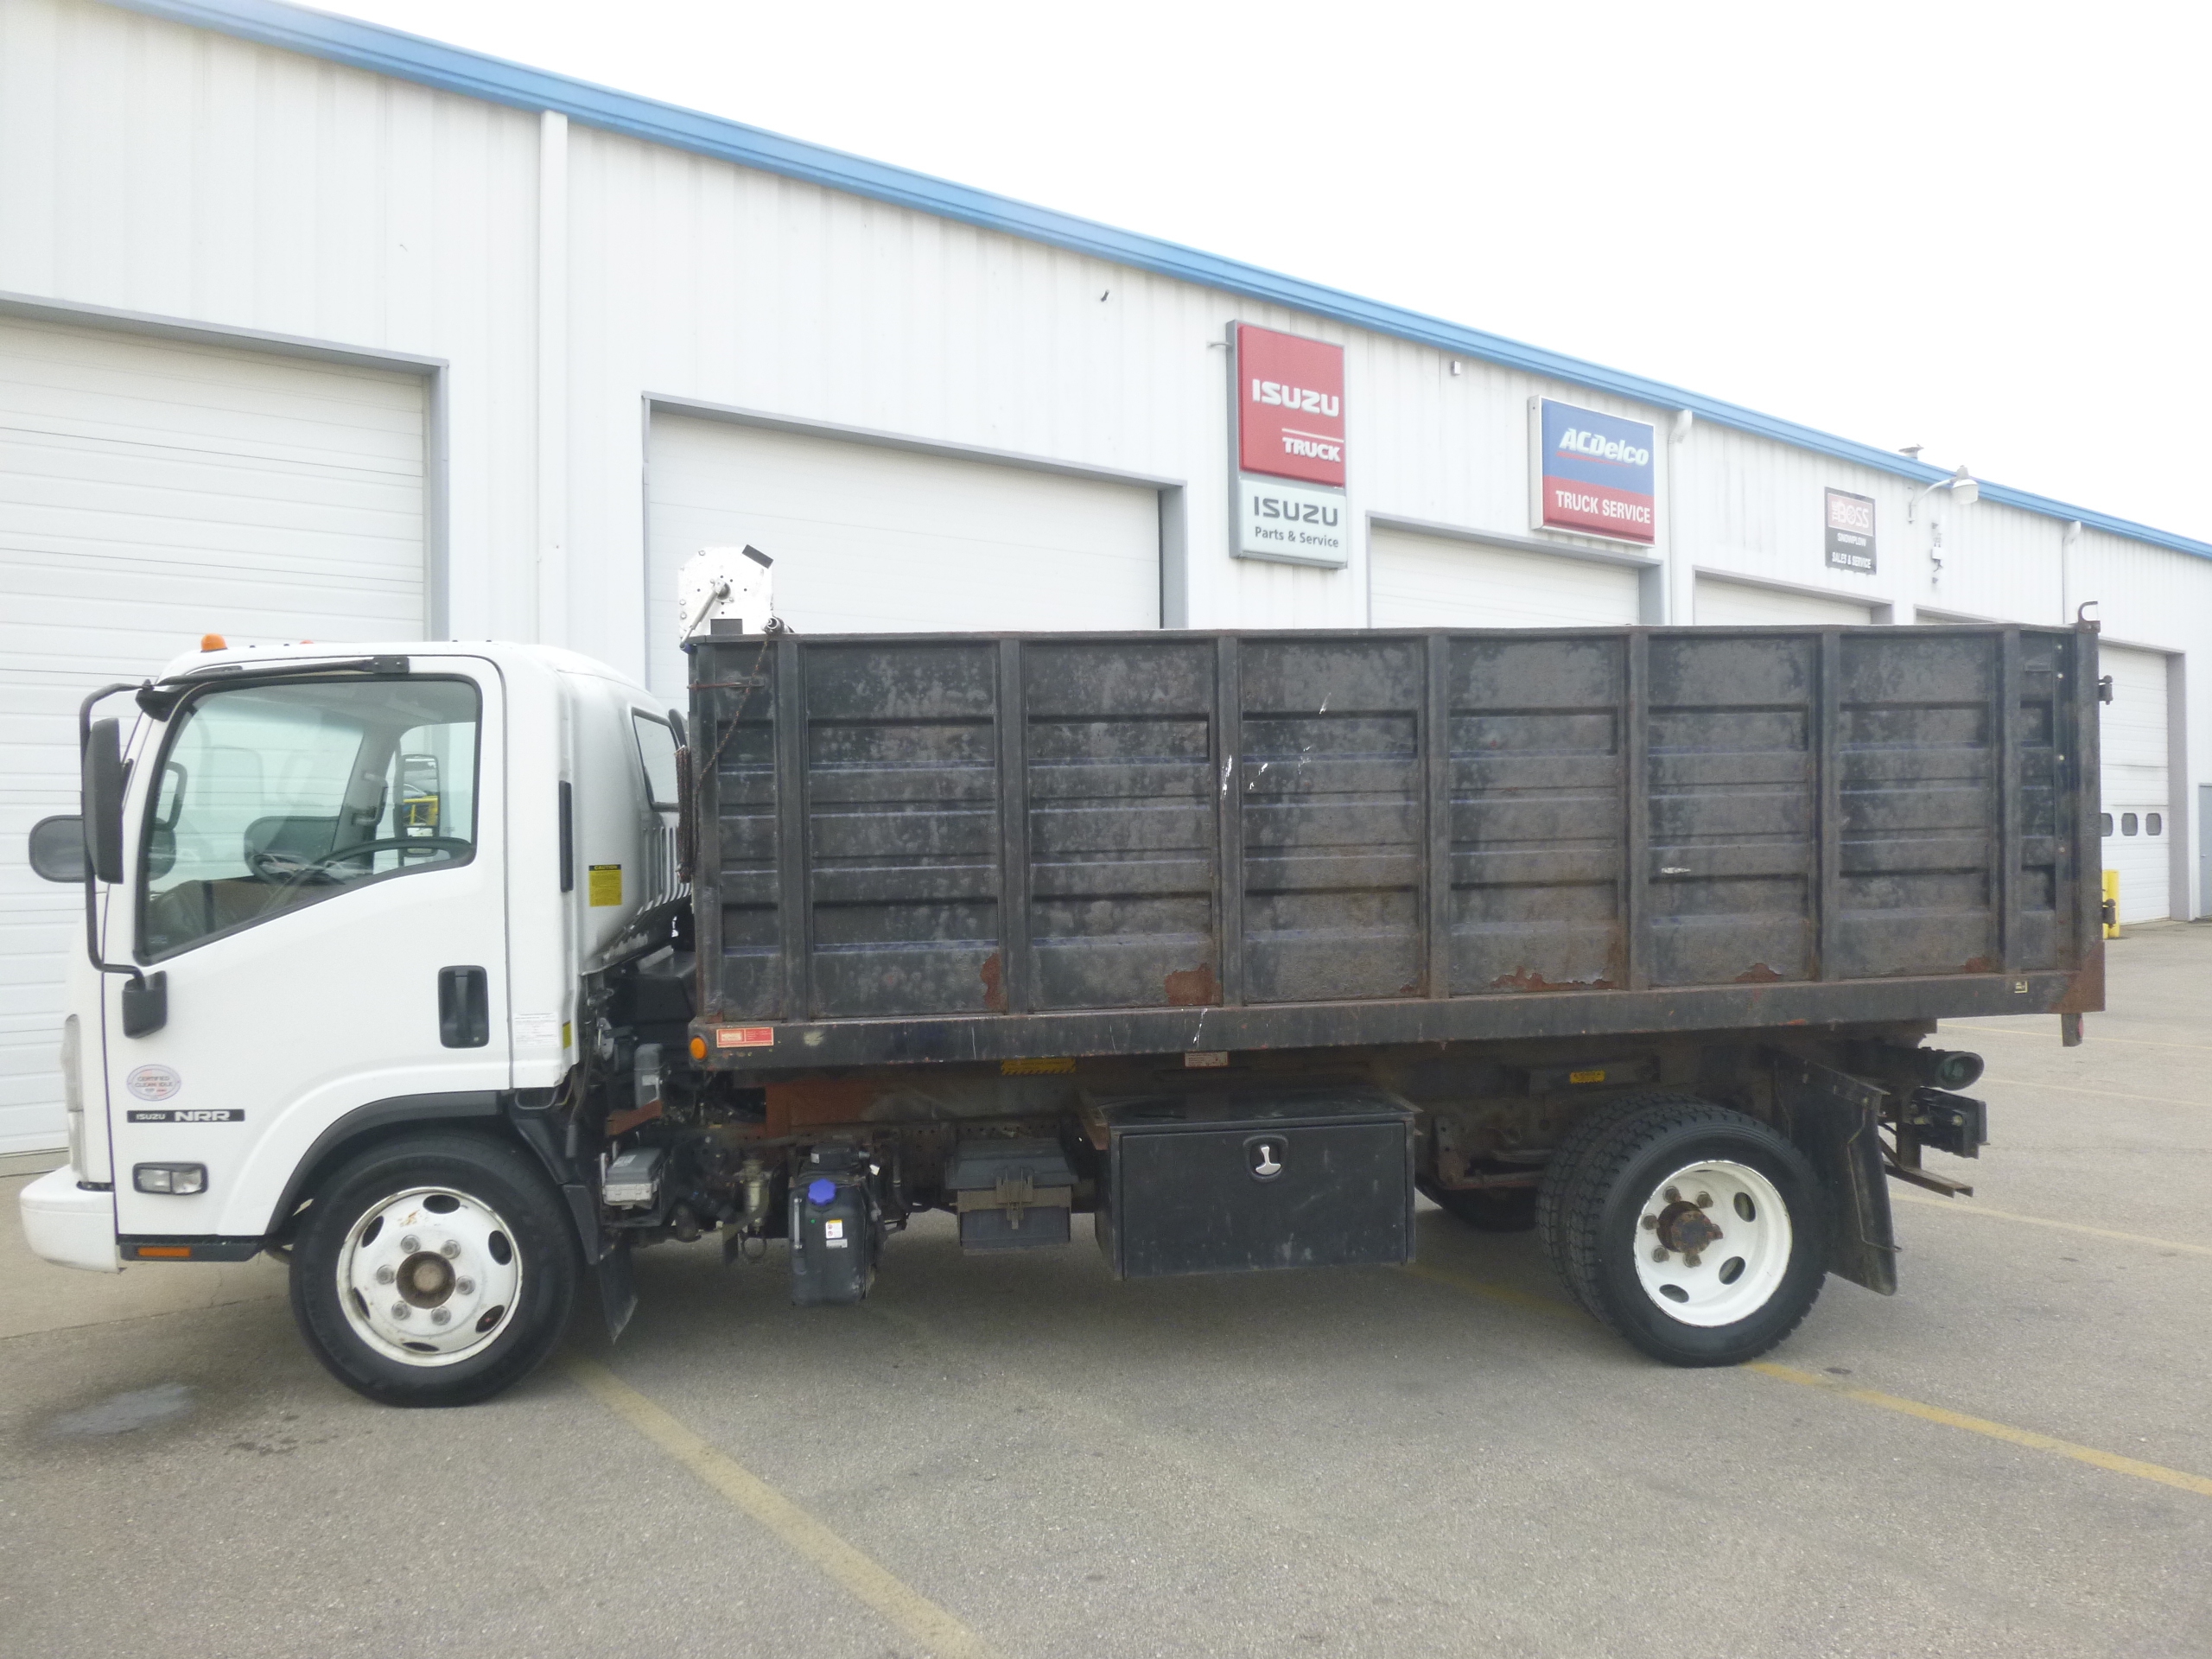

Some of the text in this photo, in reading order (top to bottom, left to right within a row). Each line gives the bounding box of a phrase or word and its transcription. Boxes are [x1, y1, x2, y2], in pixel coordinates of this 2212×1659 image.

[1252, 378, 1339, 416] ISUZU
[1282, 436, 1341, 462] TRUCK
[1559, 428, 1649, 467] ACDelco
[1254, 496, 1338, 527] ISUZU
[1555, 490, 1651, 524] TRUCK SERVICE
[1838, 502, 1869, 528] BOSS
[1255, 526, 1339, 548] Parts & Service
[1832, 552, 1872, 569] SALES & SERVICE
[175, 1111, 230, 1122] NRR
